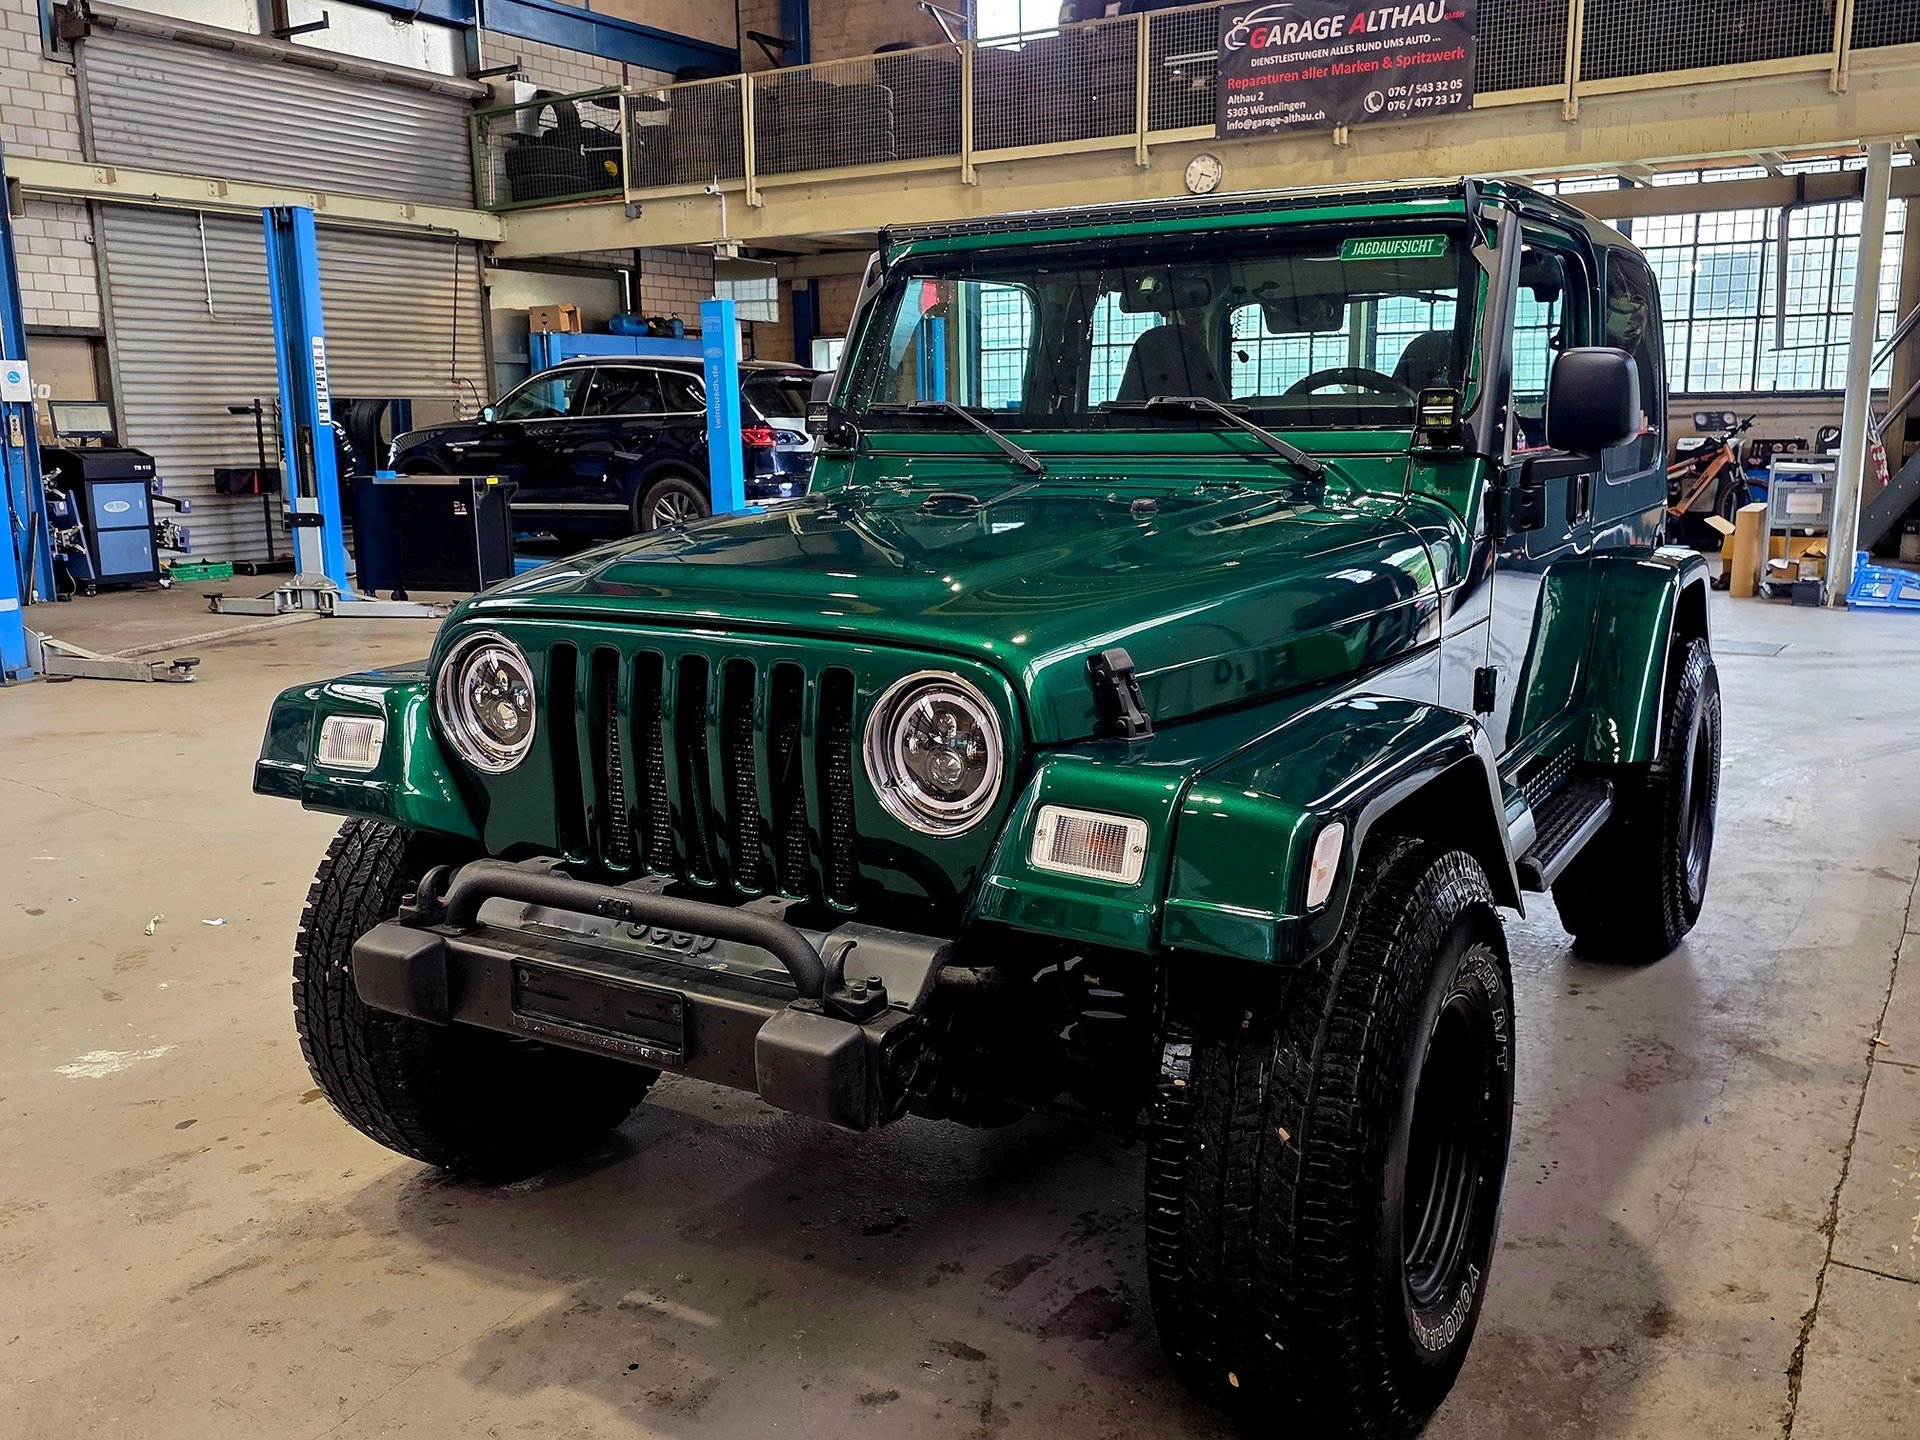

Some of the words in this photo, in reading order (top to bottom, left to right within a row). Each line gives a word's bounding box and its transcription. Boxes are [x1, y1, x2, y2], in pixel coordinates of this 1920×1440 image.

[1250, 15, 1345, 49] GARAGE
[1348, 0, 1446, 34] ALTHAU
[1251, 48, 1329, 67] DIENSTLEISTUNGEN
[1330, 45, 1354, 57] ALLES
[1355, 41, 1382, 53] RUND
[1383, 37, 1404, 48] UMS
[1405, 33, 1431, 46] AUTO
[1227, 71, 1299, 90] Reparaturen
[1301, 67, 1328, 80] aller
[1331, 60, 1379, 76] Marken
[1382, 56, 1393, 69] &
[1395, 46, 1465, 68] Spritzwerk
[1388, 86, 1407, 97] 076
[1407, 83, 1414, 97] /
[1415, 82, 1434, 94] 543
[1435, 80, 1448, 92] 32
[1450, 79, 1463, 90] 05
[1227, 93, 1257, 105] Althau
[1258, 91, 1264, 101] 2
[1387, 100, 1406, 112] 076
[1406, 98, 1413, 110] /
[1414, 96, 1433, 108] 477
[1434, 94, 1448, 106] 23
[1449, 93, 1463, 104] 17
[1227, 106, 1248, 118] 5303
[1250, 100, 1306, 115] Würenlingen
[1226, 109, 1326, 131] info@garage-althau.ch
[1350, 238, 1435, 256] JAGDAUFSICHT
